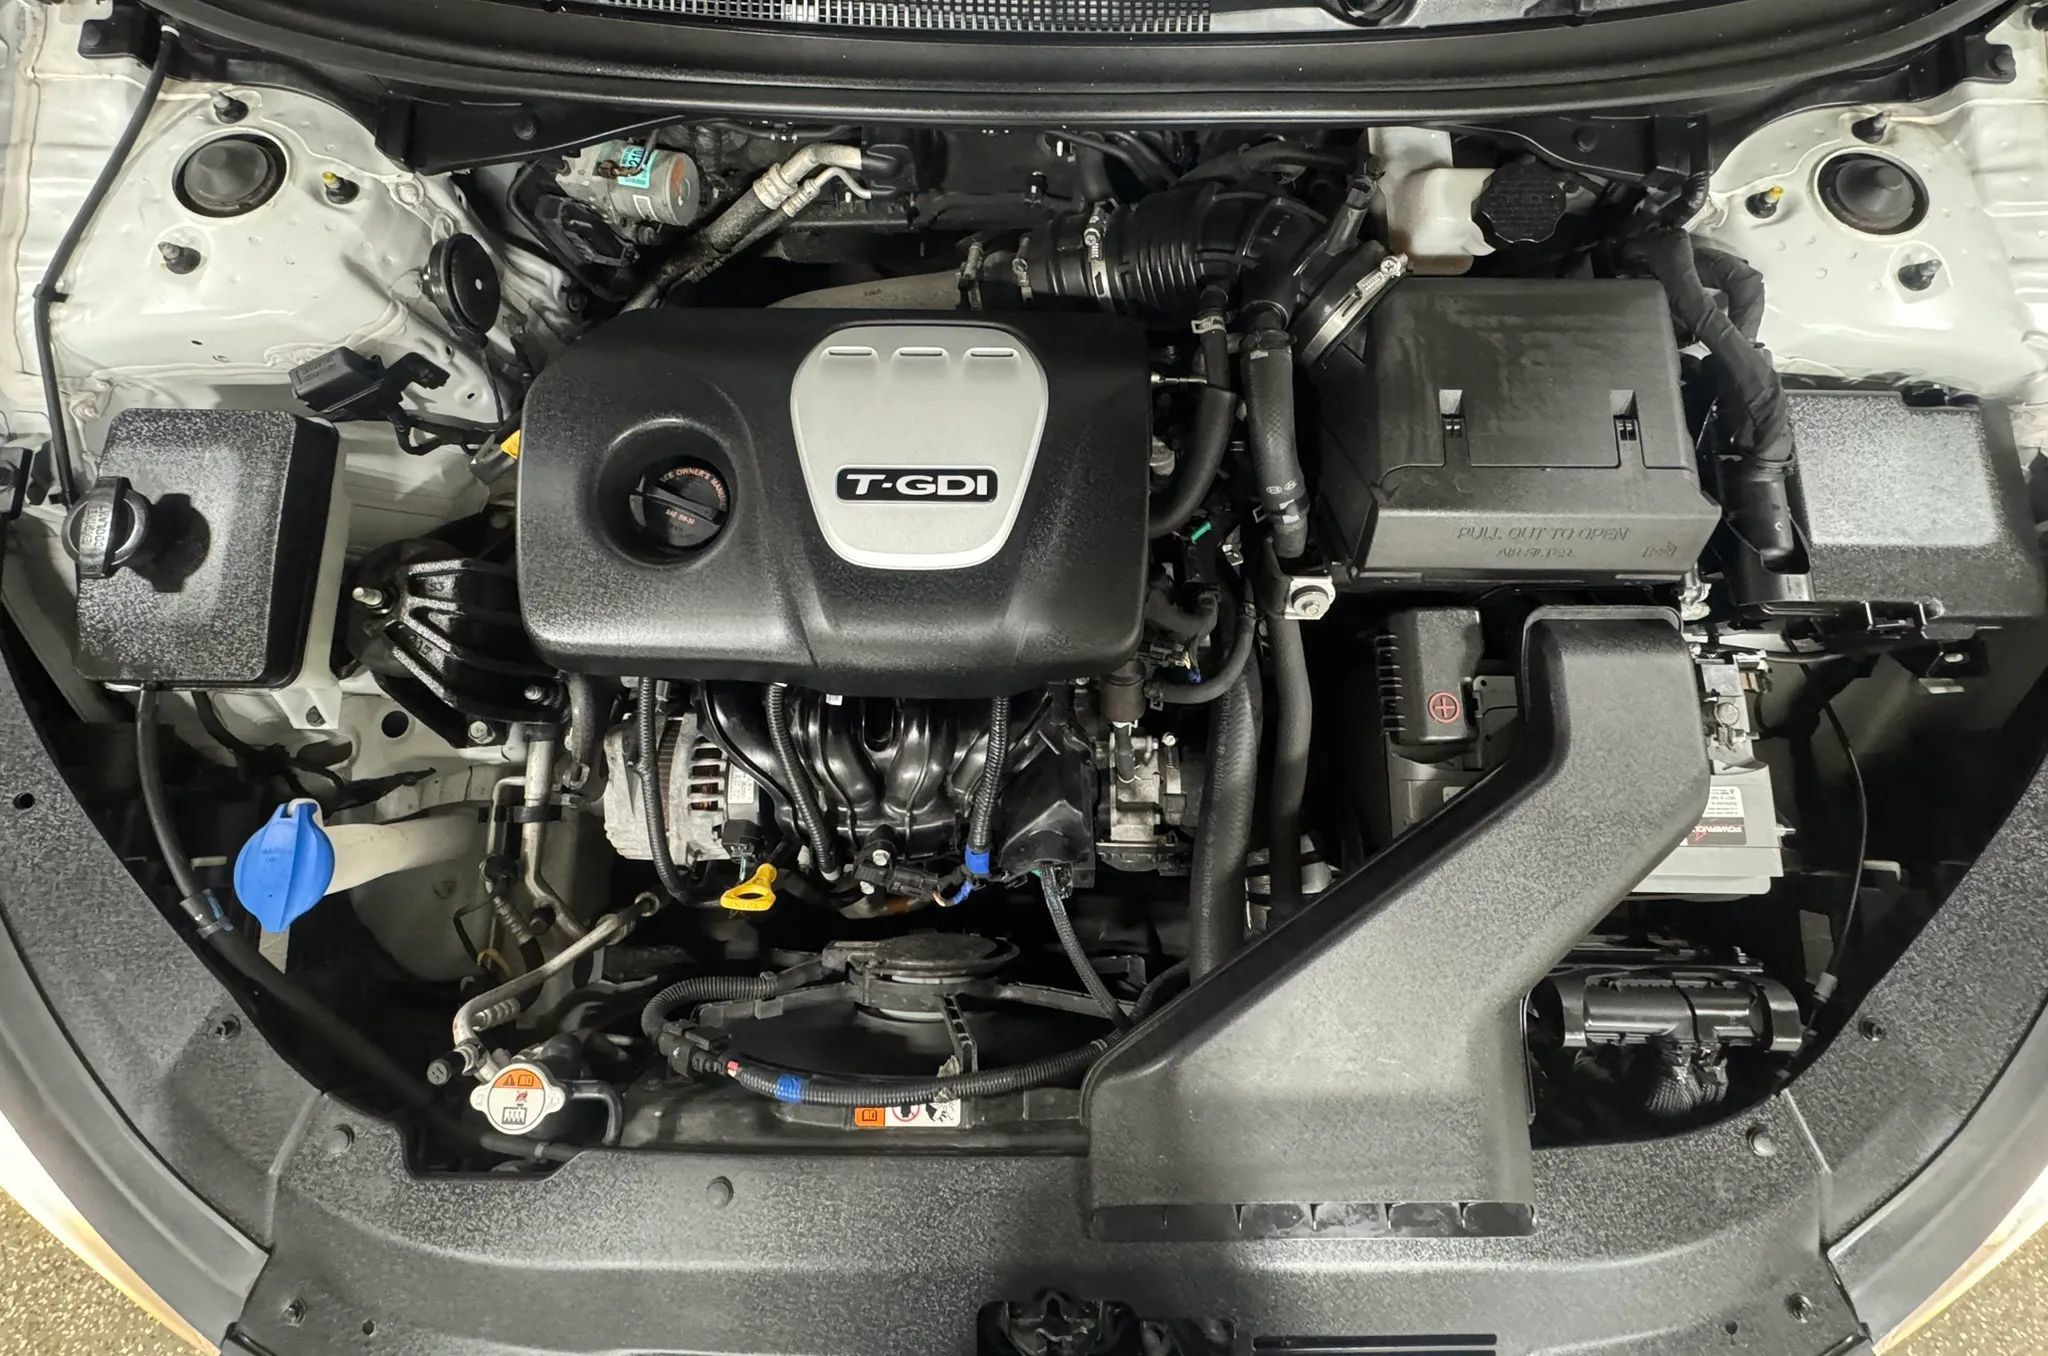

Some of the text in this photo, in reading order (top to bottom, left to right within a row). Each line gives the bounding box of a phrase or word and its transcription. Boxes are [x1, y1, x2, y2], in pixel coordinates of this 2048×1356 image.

[676, 467, 711, 480] OWNER'S
[711, 478, 728, 511] MANUAL
[846, 474, 988, 496] T-GDI
[94, 505, 110, 548] COOLANT
[1457, 527, 1630, 541] PULL OUT TO OPEN
[1496, 547, 1521, 558] AIR
